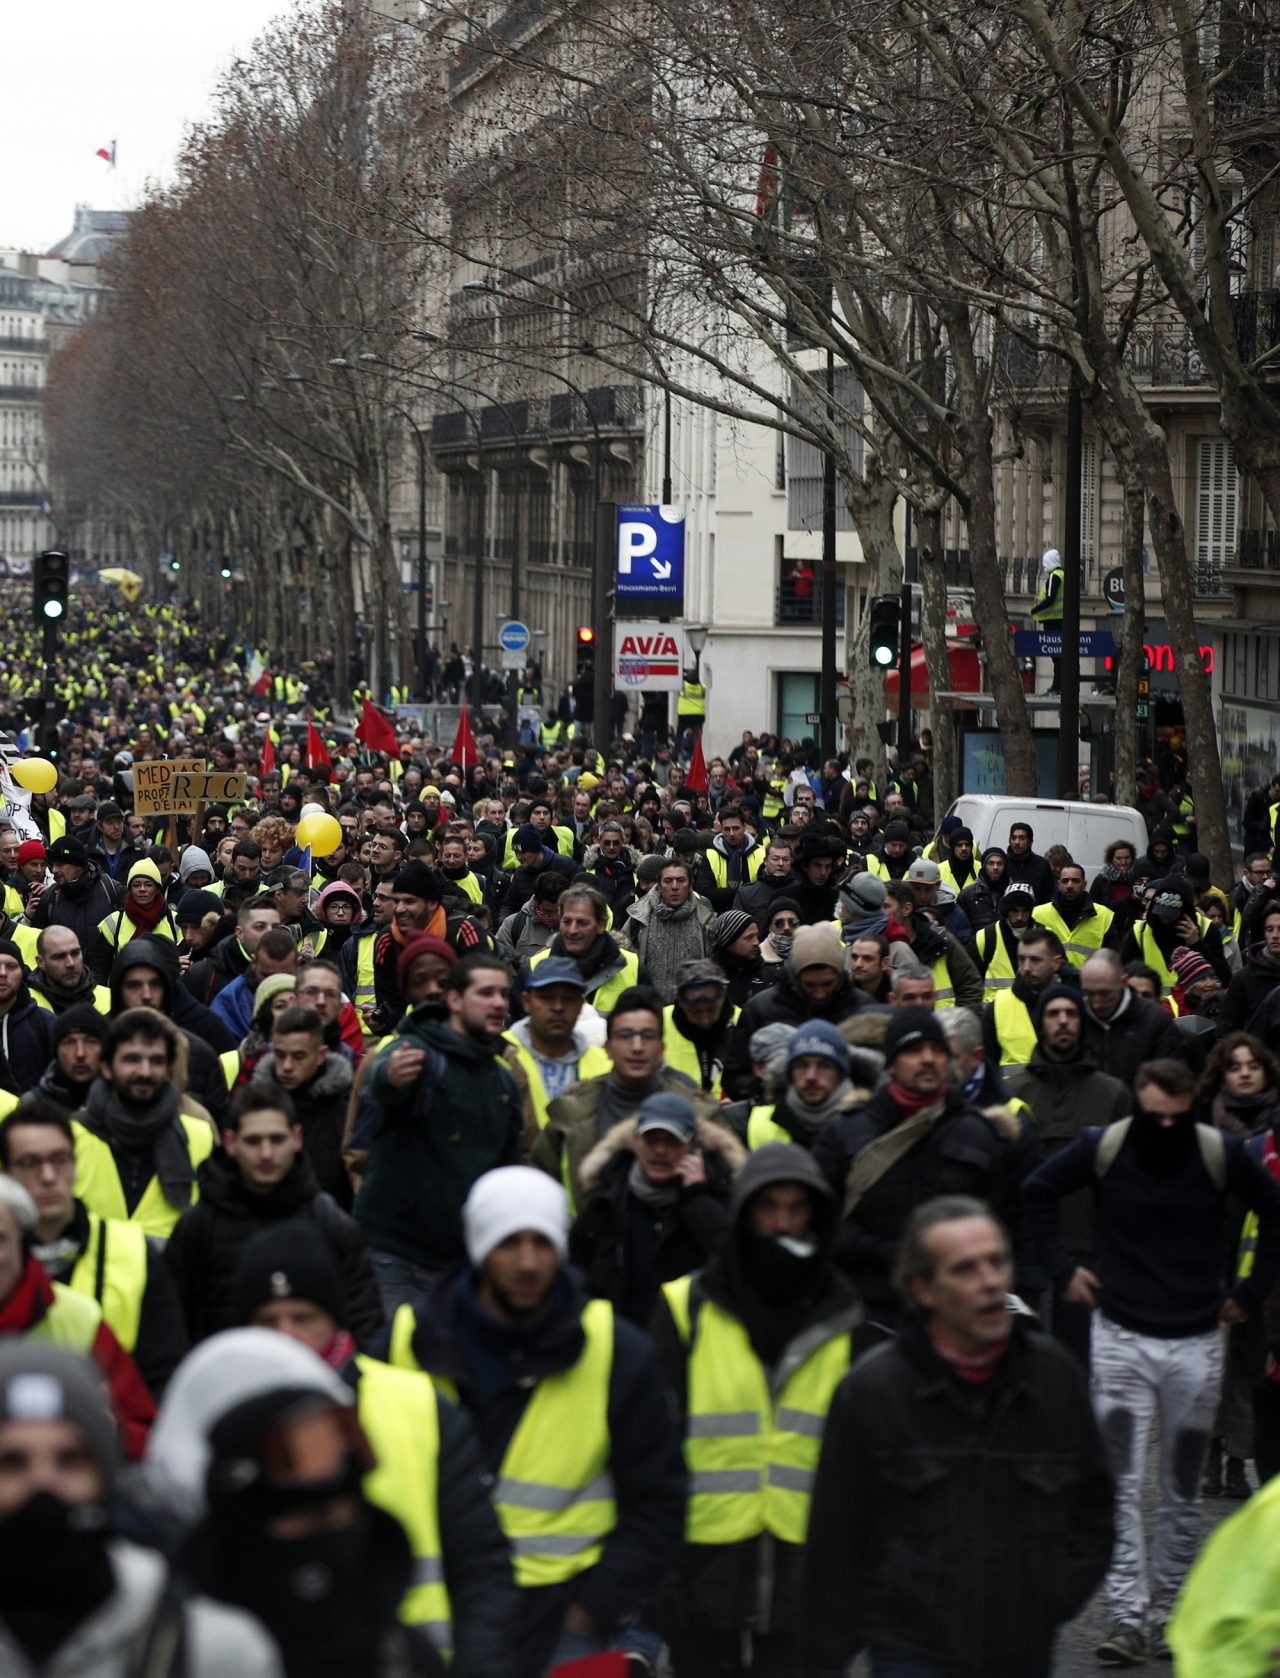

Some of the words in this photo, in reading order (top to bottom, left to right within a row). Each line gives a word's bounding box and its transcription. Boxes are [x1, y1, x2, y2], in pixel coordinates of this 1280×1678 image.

[618, 522, 657, 574] P
[620, 633, 678, 655] AVIA
[1039, 634, 1091, 644] Hausnn
[1041, 645, 1088, 655] Coures
